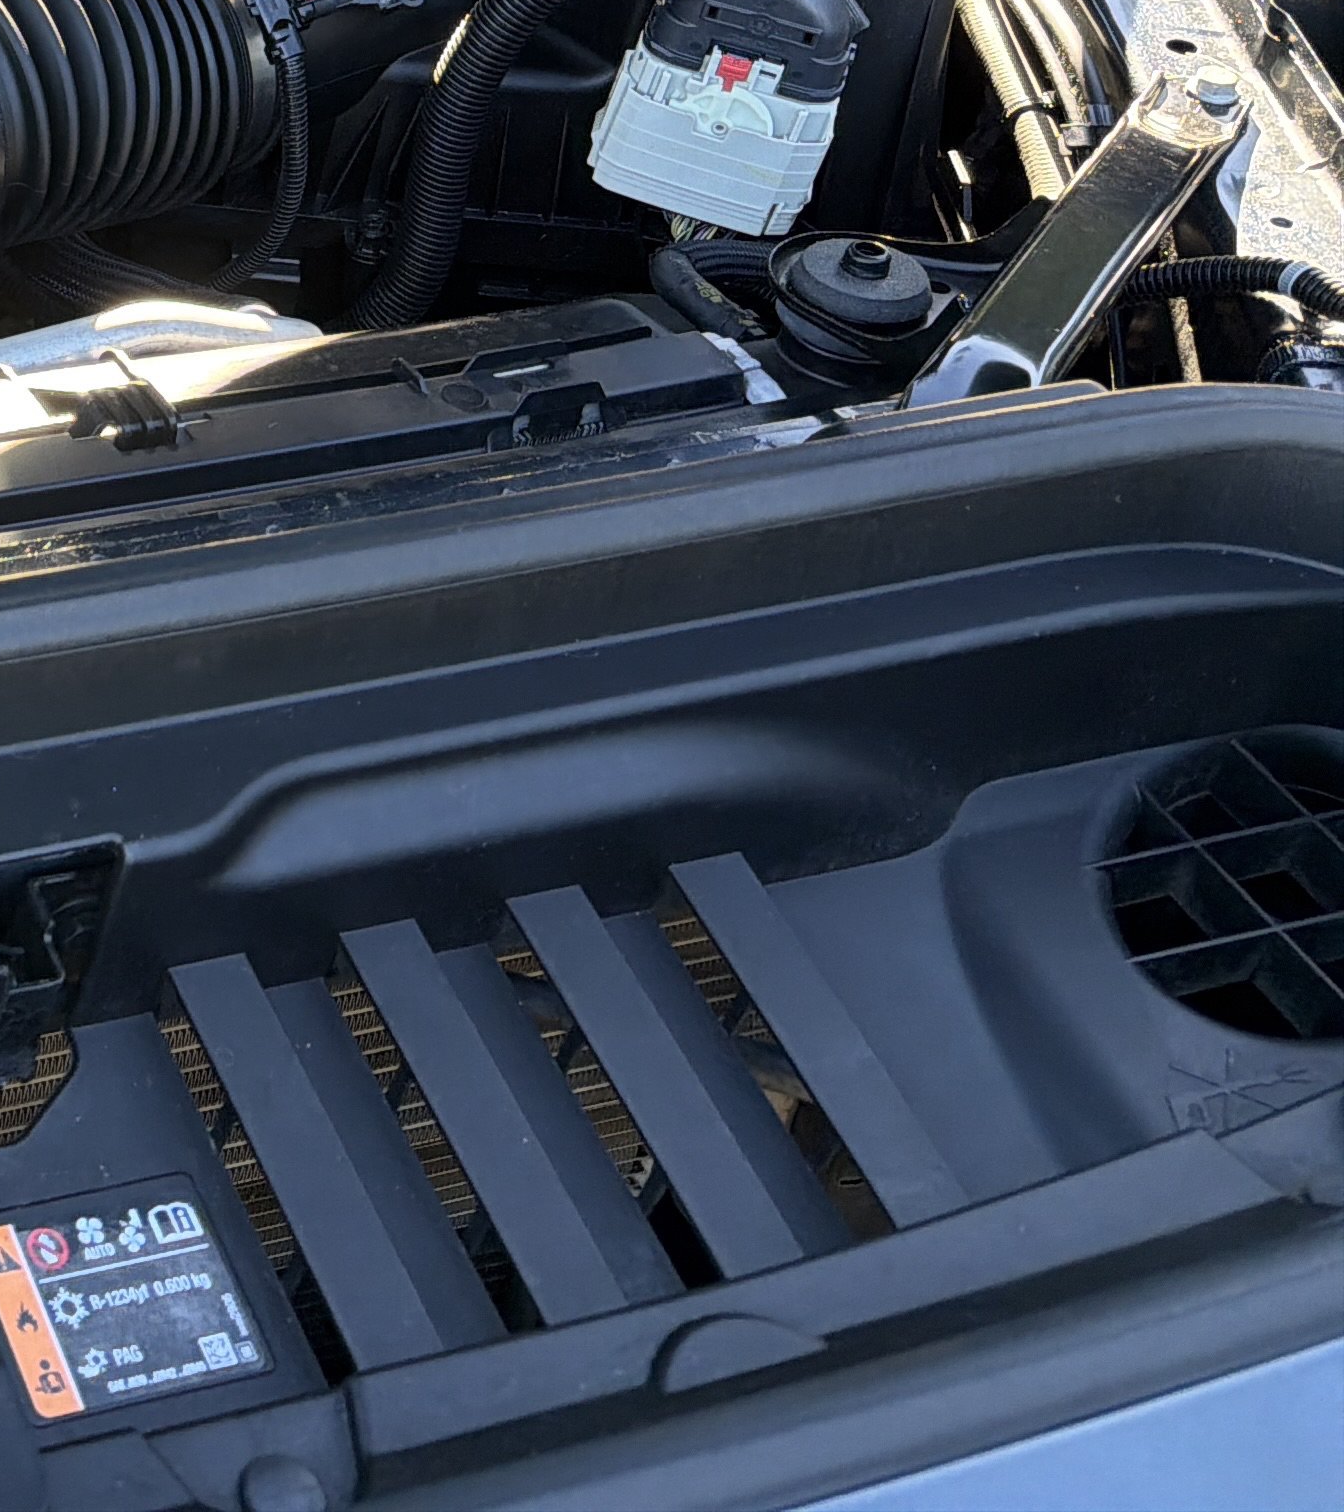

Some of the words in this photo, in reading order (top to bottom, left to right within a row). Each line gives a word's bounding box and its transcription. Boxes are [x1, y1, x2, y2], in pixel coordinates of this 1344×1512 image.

[84, 1242, 115, 1261] AUTO
[89, 1285, 150, 1311] R-1234yf
[191, 1271, 212, 1291] kg
[112, 1345, 144, 1367] PAG
